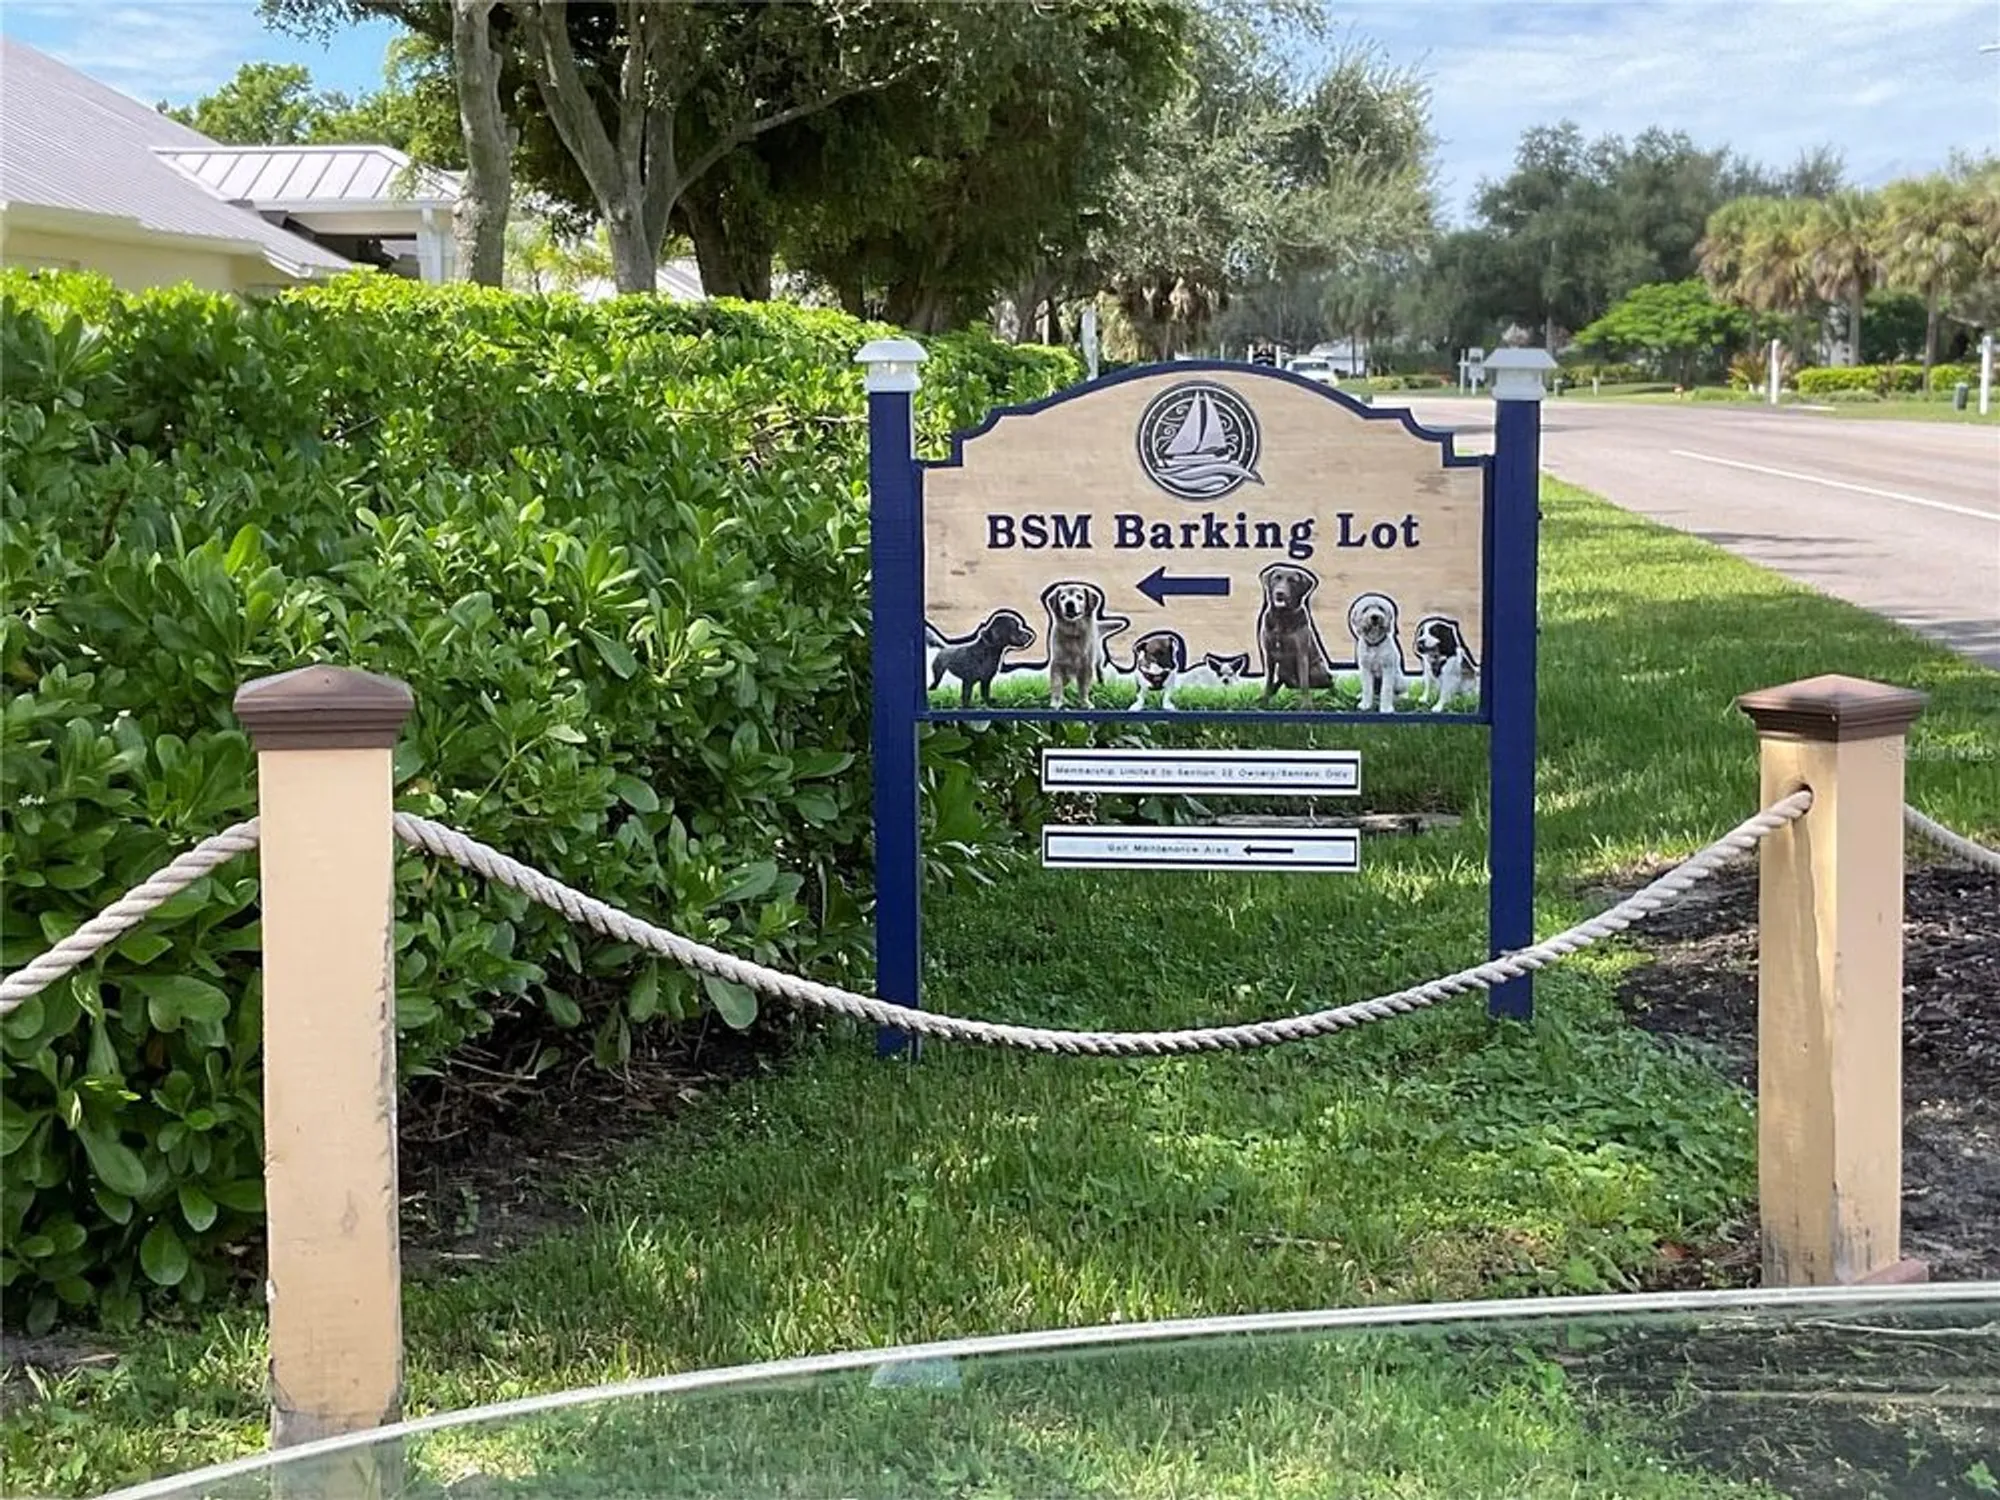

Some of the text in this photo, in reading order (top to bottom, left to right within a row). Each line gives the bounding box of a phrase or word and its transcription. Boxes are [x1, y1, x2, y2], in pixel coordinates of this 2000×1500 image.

[986, 512, 1421, 559] BSM Barking Lot
[1055, 766, 1114, 776] Memershp
[1119, 767, 1156, 777] Limte
[1133, 844, 1199, 853] Maenance
